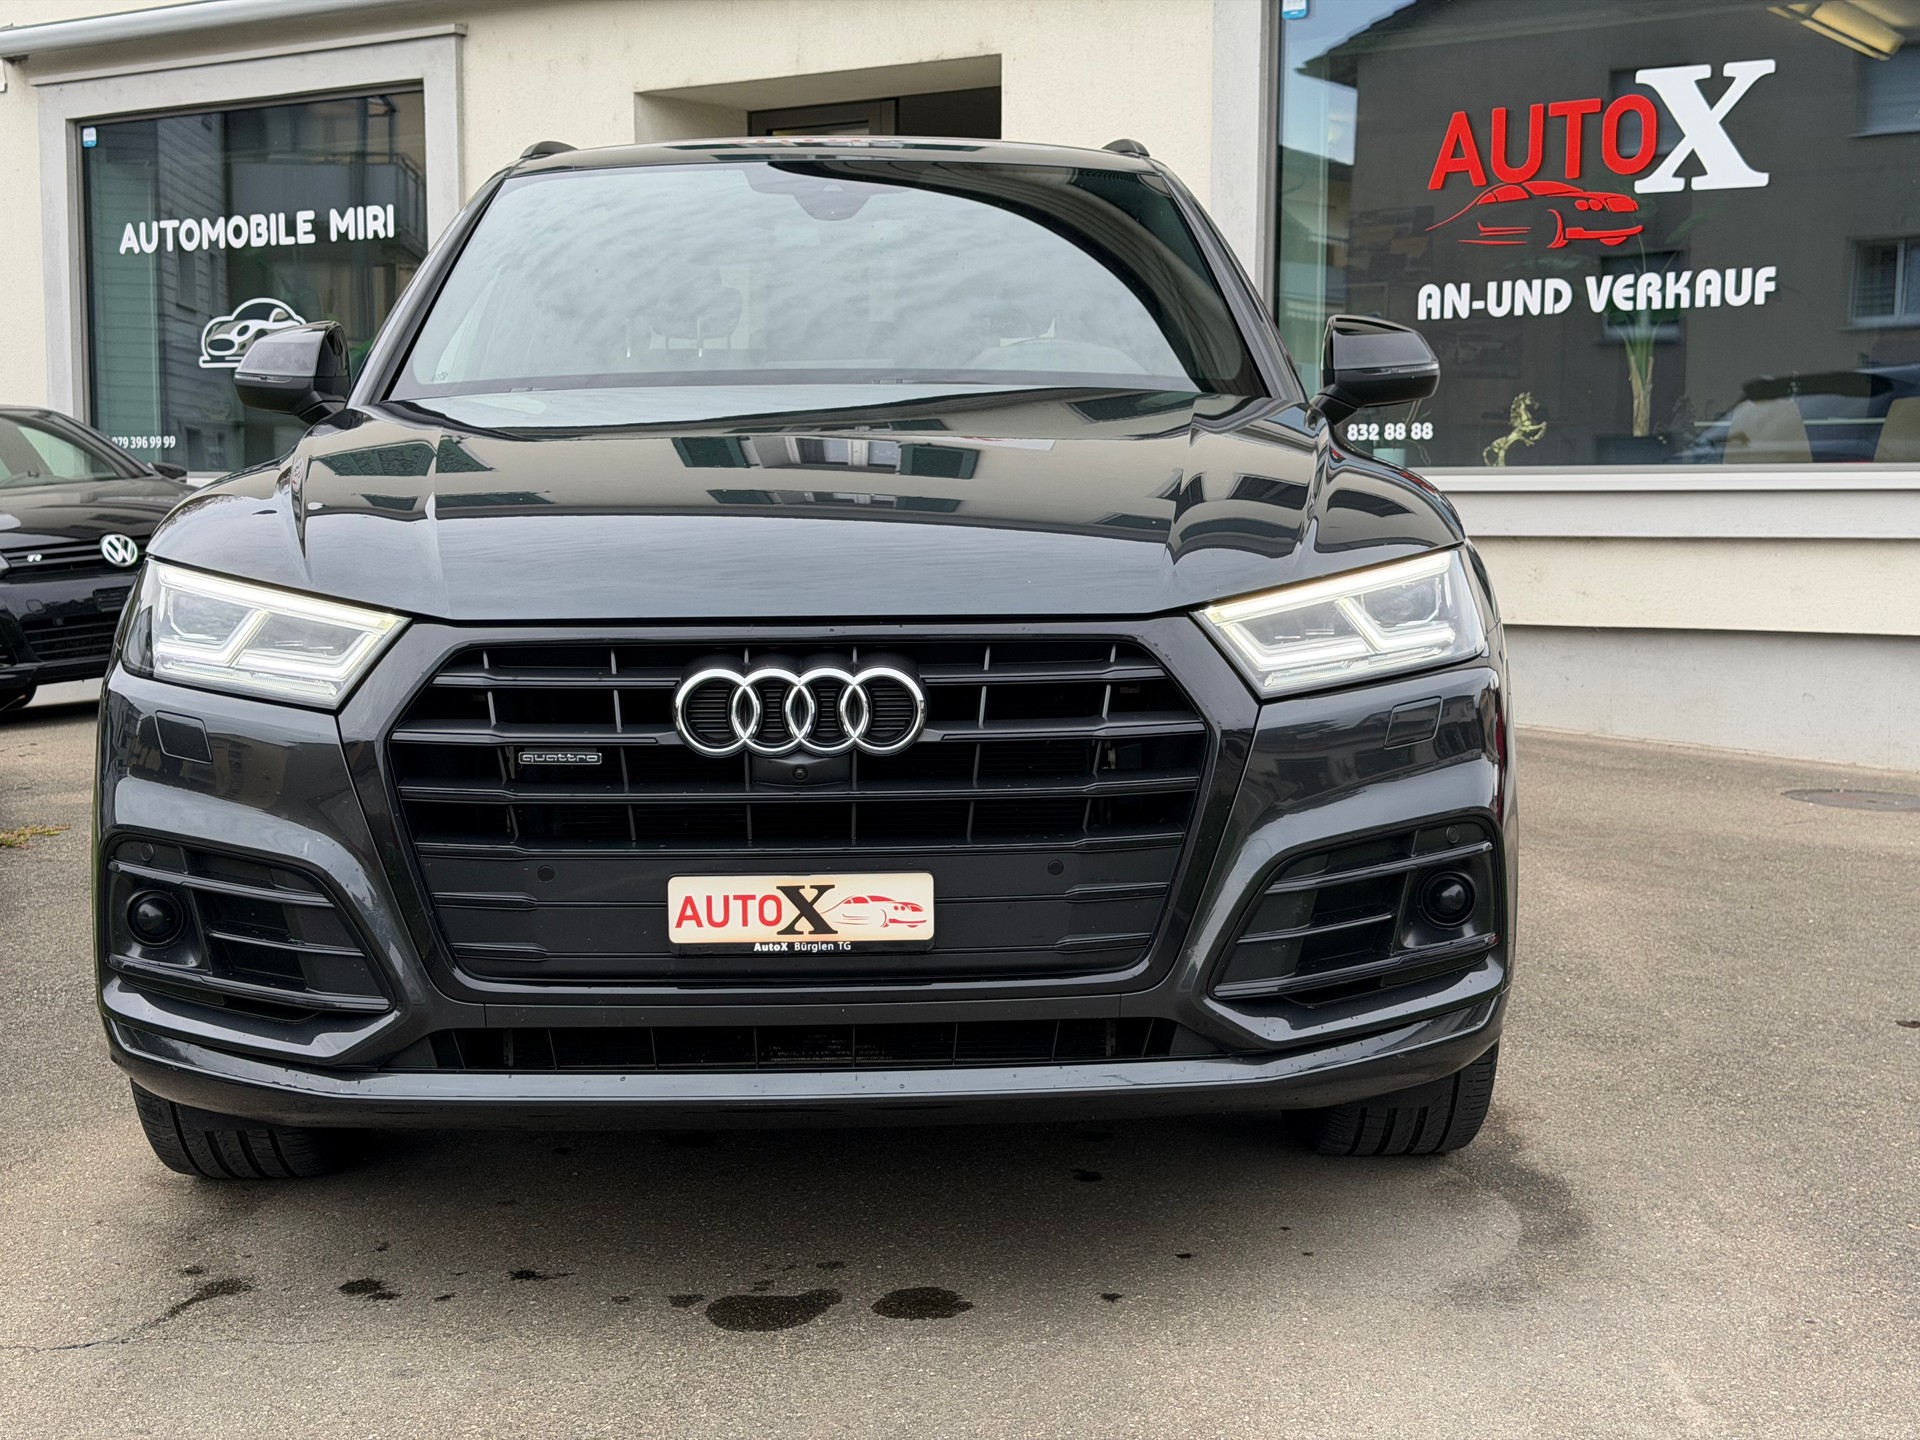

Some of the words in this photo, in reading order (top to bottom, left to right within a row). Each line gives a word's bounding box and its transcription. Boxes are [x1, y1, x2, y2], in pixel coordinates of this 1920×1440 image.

[119, 210, 316, 255] AUTOMOBILE
[329, 204, 394, 242] MIRI
[1417, 278, 1573, 320] AN-UND
[1585, 266, 1777, 313] VERKAUF
[1347, 423, 1380, 441] 832
[1384, 423, 1406, 440] 88
[1411, 422, 1433, 440] 88
[130, 436, 148, 449] 396
[150, 435, 162, 449] 99
[163, 435, 176, 449] 99
[522, 753, 598, 763] quattro
[753, 942, 788, 952] AutoX
[794, 942, 834, 953] Bürglen
[838, 941, 851, 950] TG
